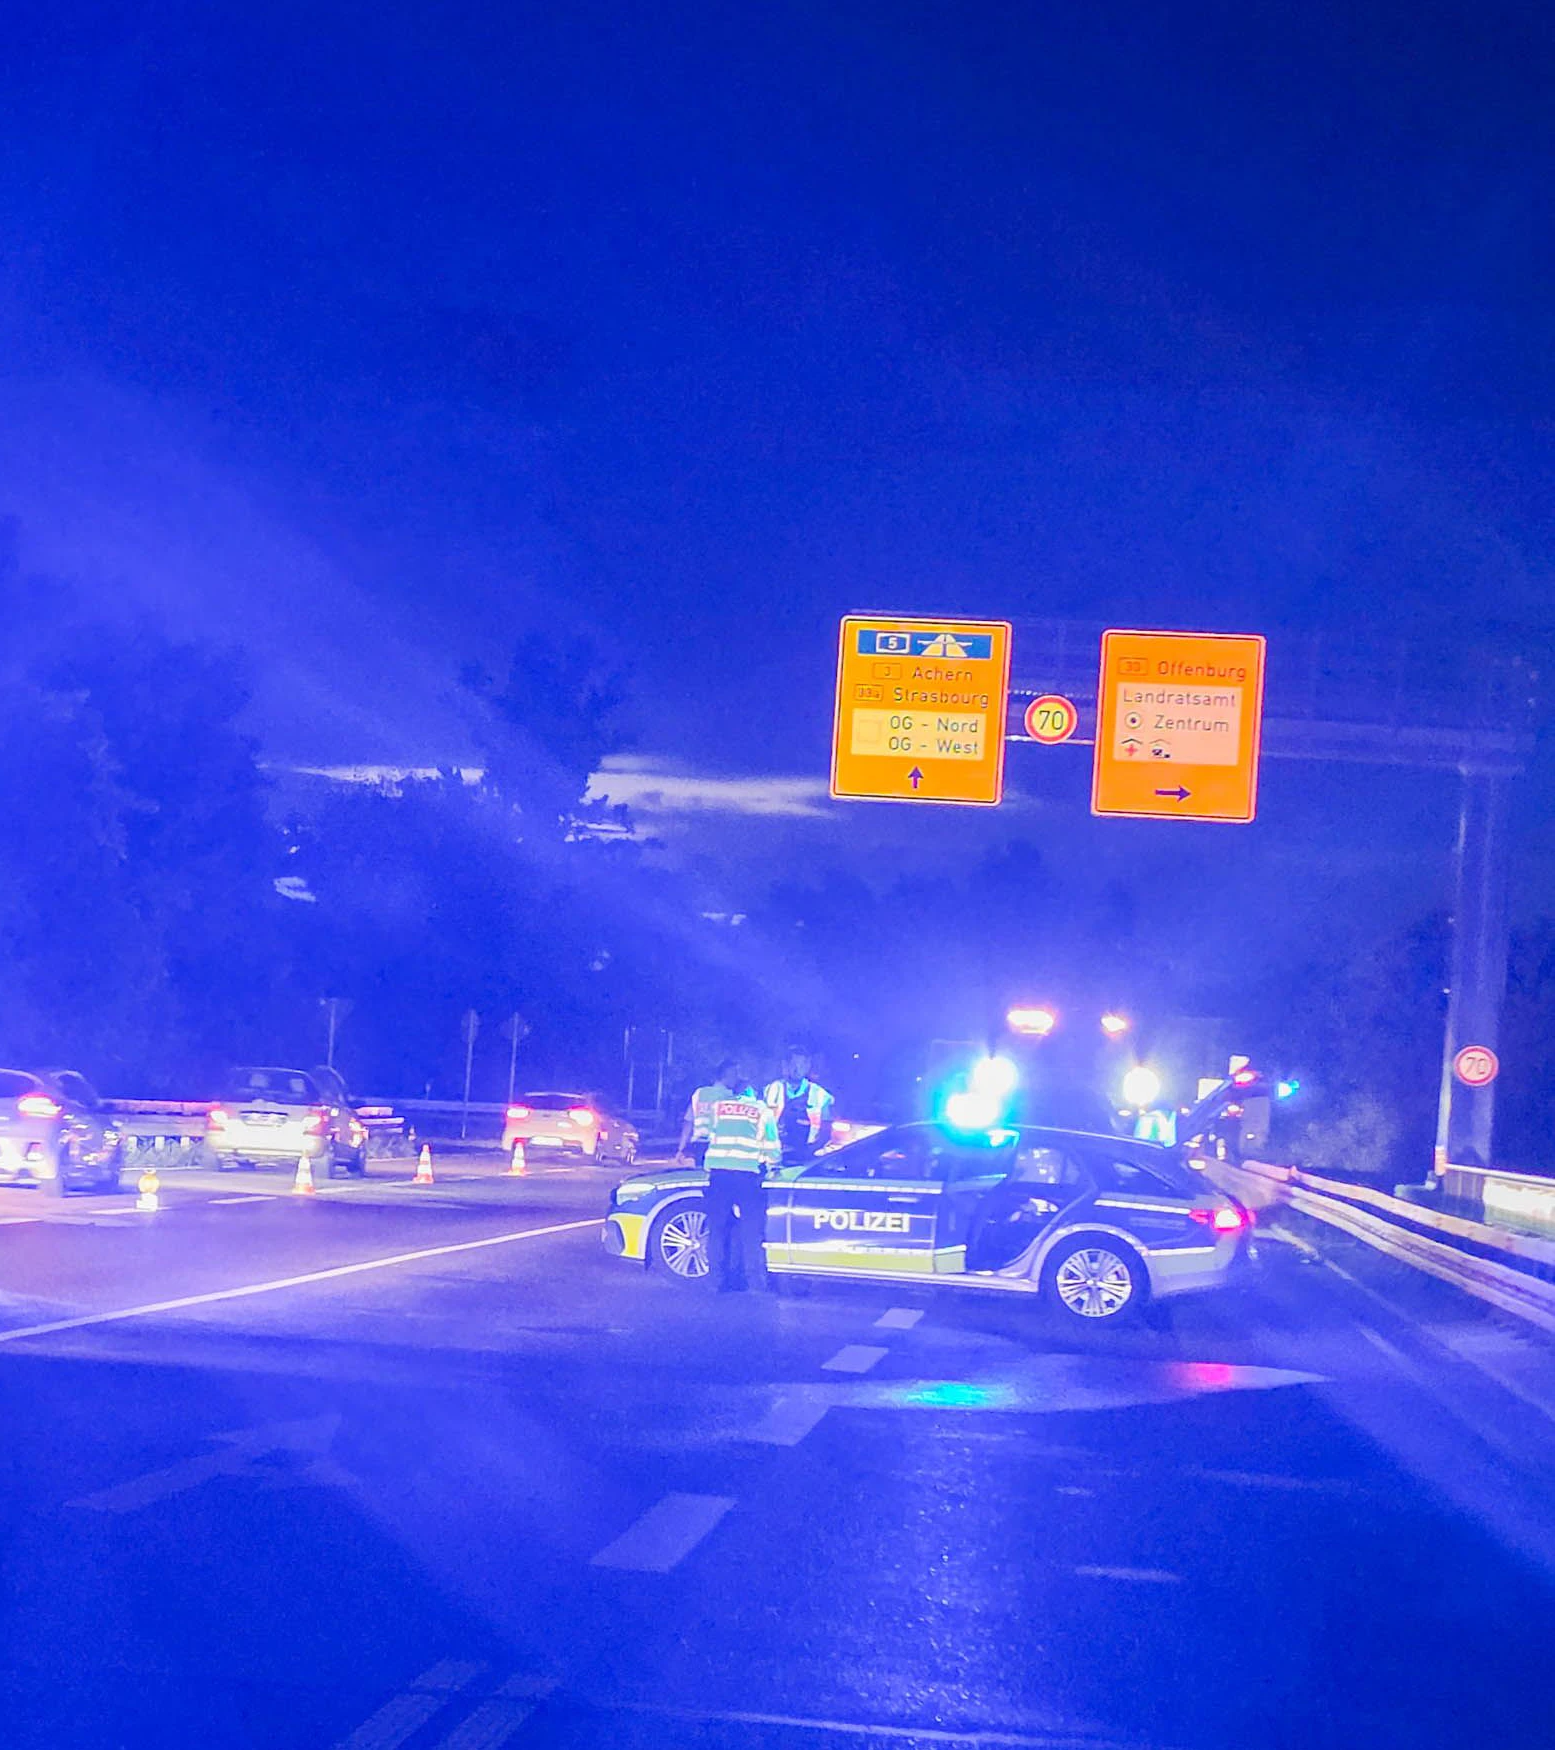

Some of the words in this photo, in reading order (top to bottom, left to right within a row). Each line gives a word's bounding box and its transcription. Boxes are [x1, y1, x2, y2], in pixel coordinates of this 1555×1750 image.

[888, 636, 898, 649] 5
[912, 666, 973, 682] Achern
[1157, 660, 1247, 682] Offenburg
[893, 687, 989, 709] Strasbourg
[1122, 688, 1236, 707] Landratsamt
[890, 715, 913, 730] OG
[937, 717, 979, 733] Nord
[1038, 710, 1065, 731] 70
[1154, 714, 1230, 732] Zentrum
[888, 736, 912, 751] OG
[937, 739, 978, 754] West
[1466, 1056, 1487, 1075] 70
[813, 1208, 911, 1233] POLIZEI
